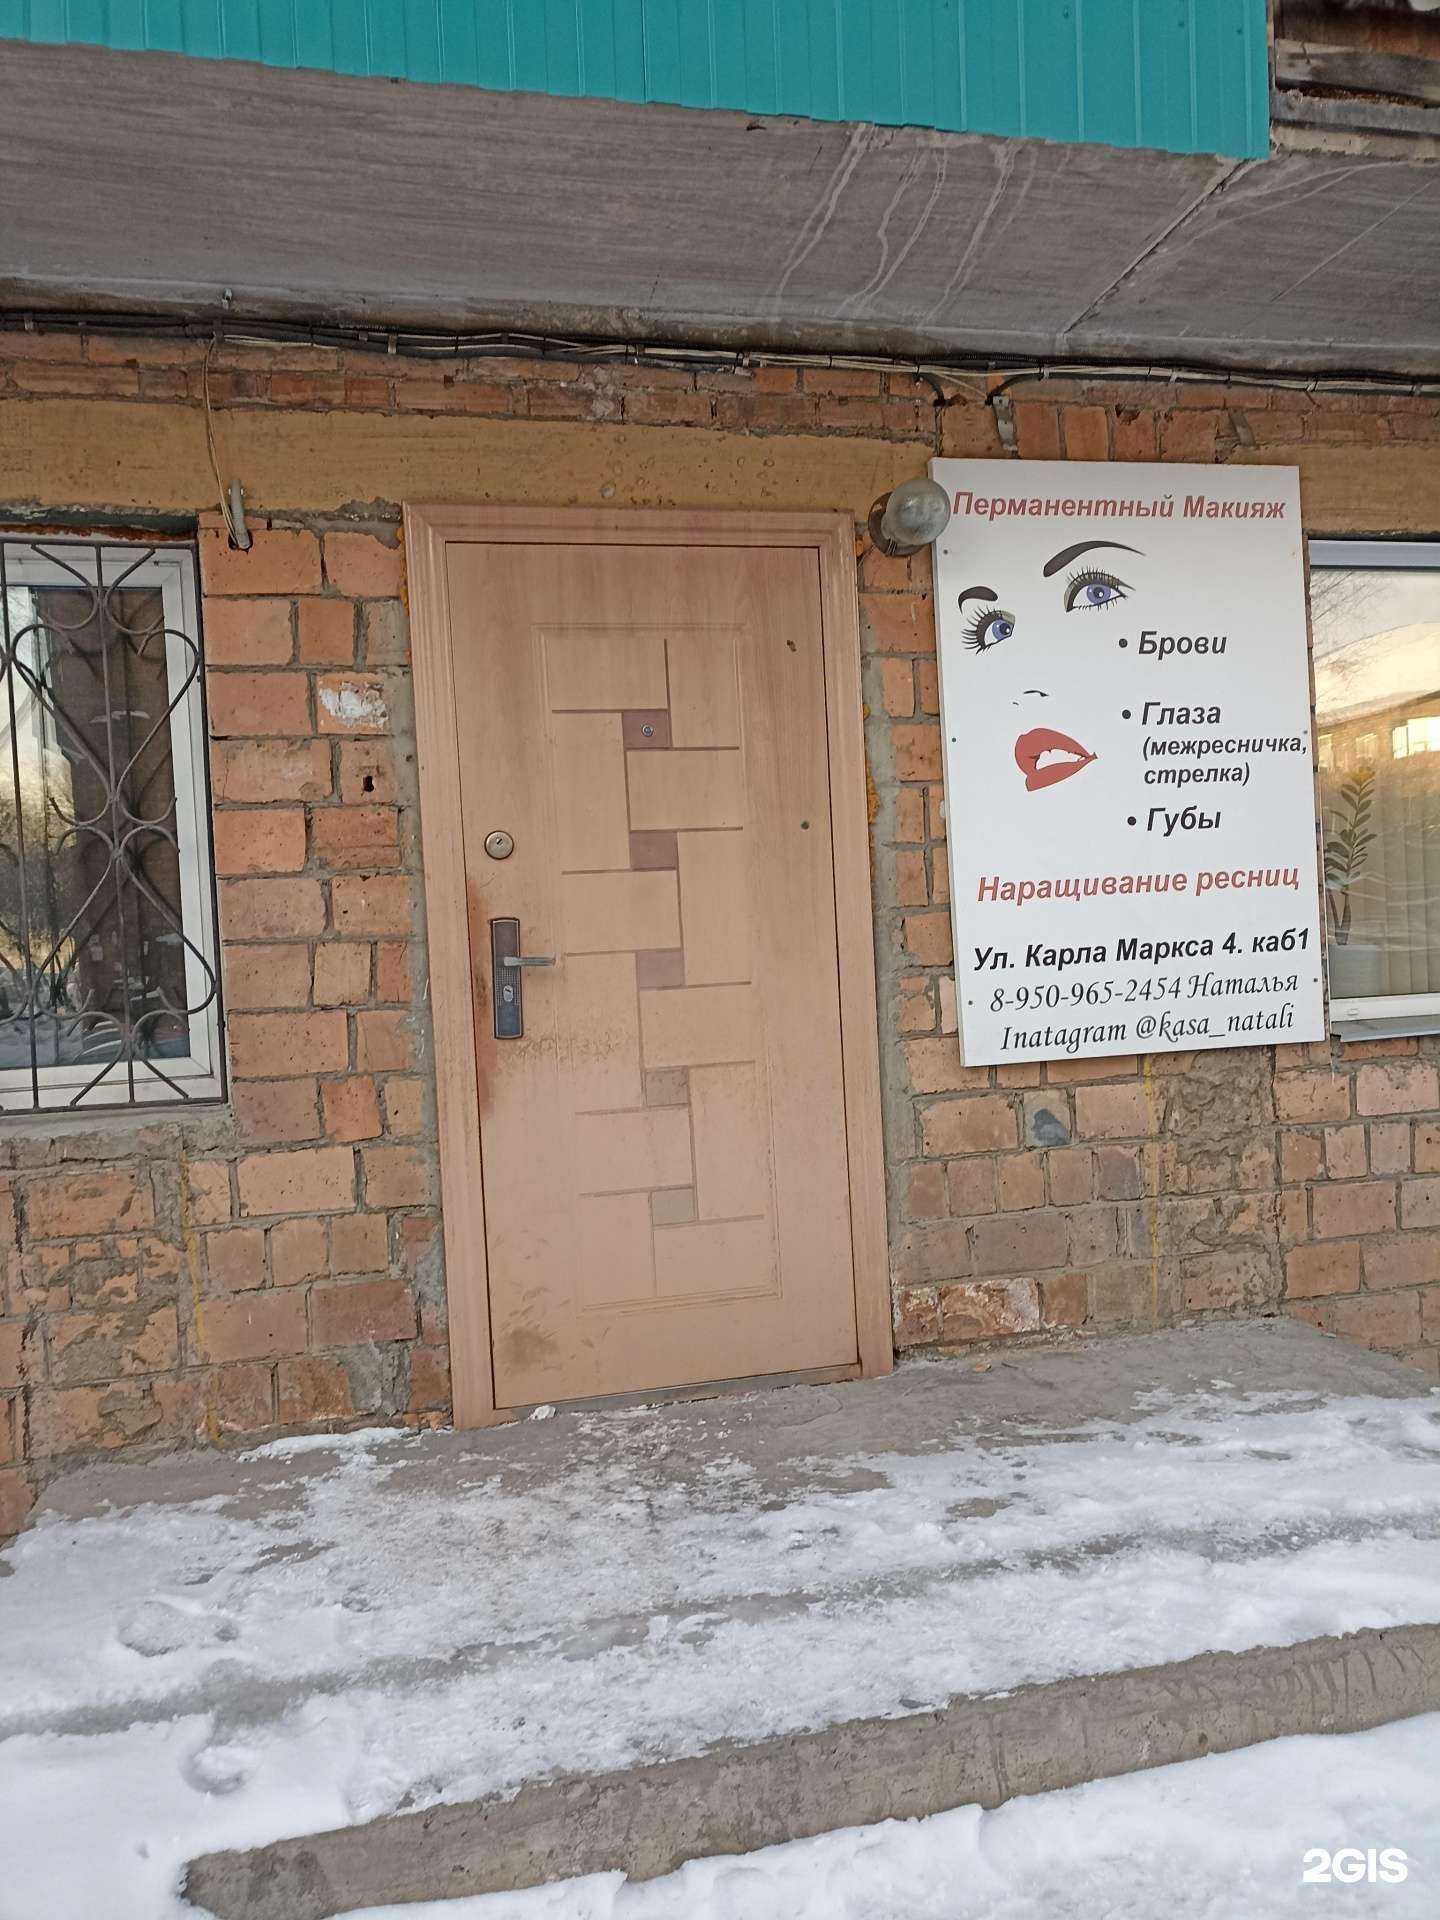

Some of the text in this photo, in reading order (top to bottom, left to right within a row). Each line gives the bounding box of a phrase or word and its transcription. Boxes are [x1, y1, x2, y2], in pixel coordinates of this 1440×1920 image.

[952, 491, 1286, 521] Перманентный Макияж
[1137, 630, 1228, 661] Брови
[1141, 701, 1222, 726] Глаза
[1142, 734, 1308, 763] (межресничка,
[1143, 762, 1250, 788] стрелка)
[1146, 805, 1221, 837] Губы
[976, 867, 1301, 906] Наращивание ресниц
[973, 927, 1310, 972] Ул. Карла Маркса 4. каб1
[989, 970, 1300, 1013] 8-950-965-2454 Наталья
[1000, 1002, 1295, 1054] Inatagram @kasa_natali
